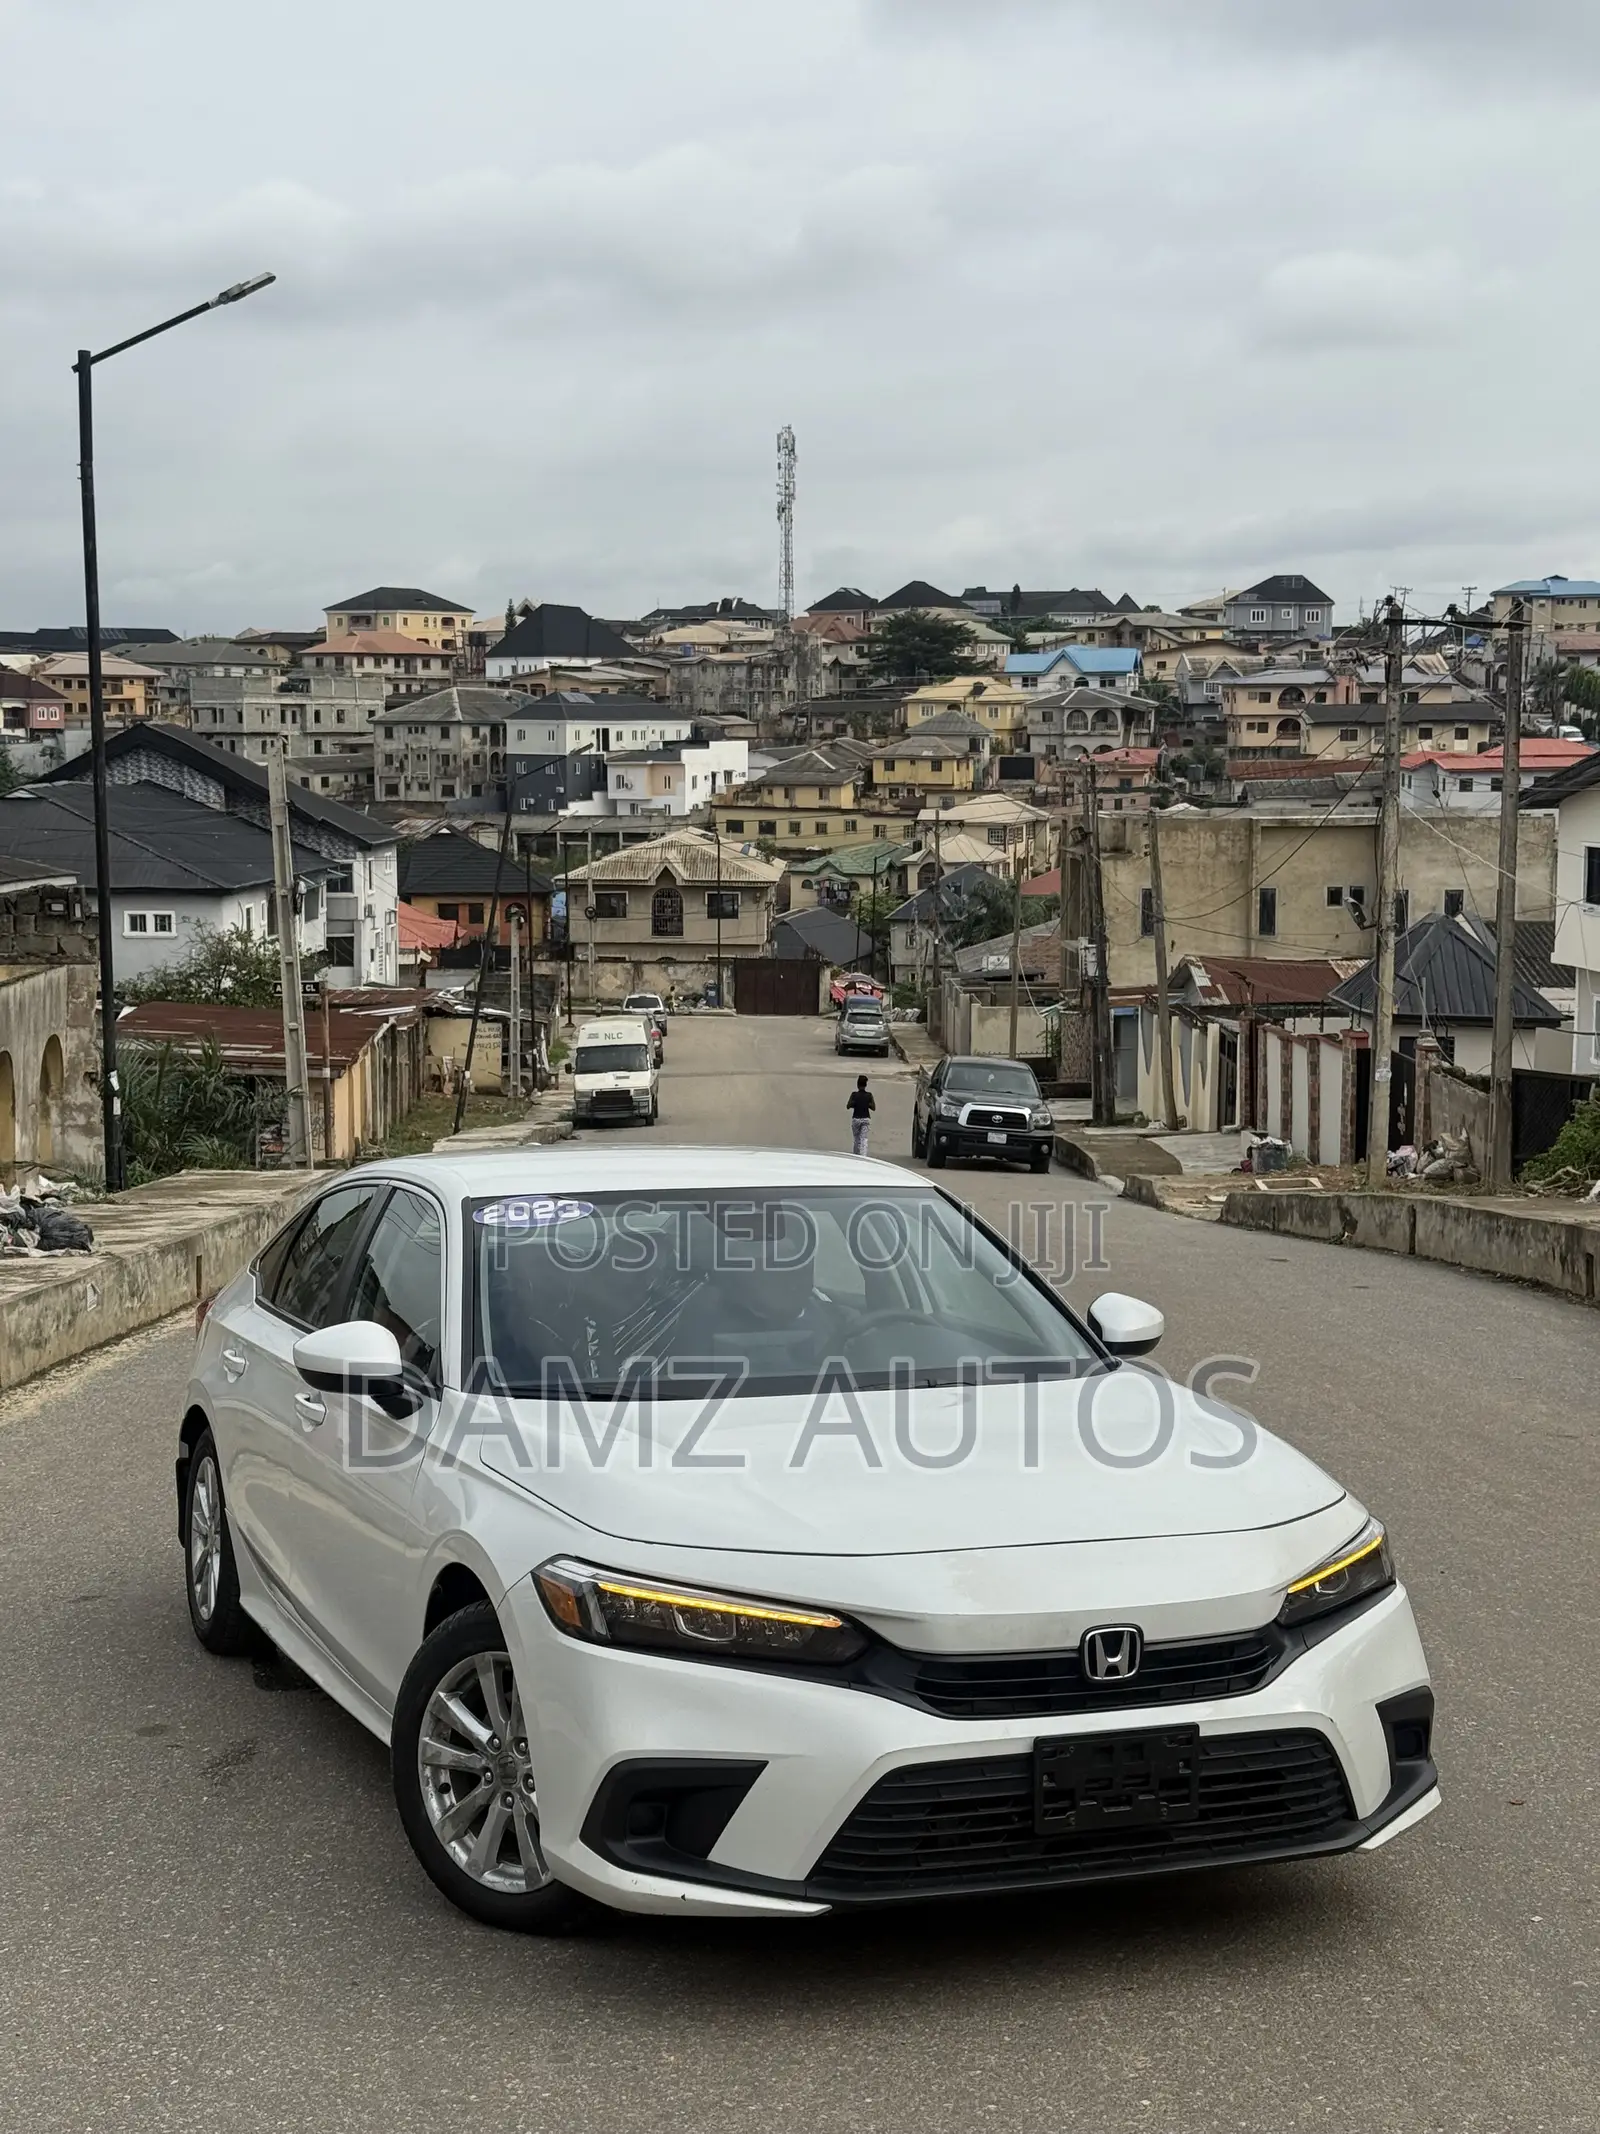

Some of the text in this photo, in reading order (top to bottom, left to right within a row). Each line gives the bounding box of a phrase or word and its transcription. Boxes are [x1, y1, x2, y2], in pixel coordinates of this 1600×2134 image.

[305, 984, 316, 992] CL
[604, 1032, 623, 1041] NLC
[483, 1200, 580, 1224] 2023
